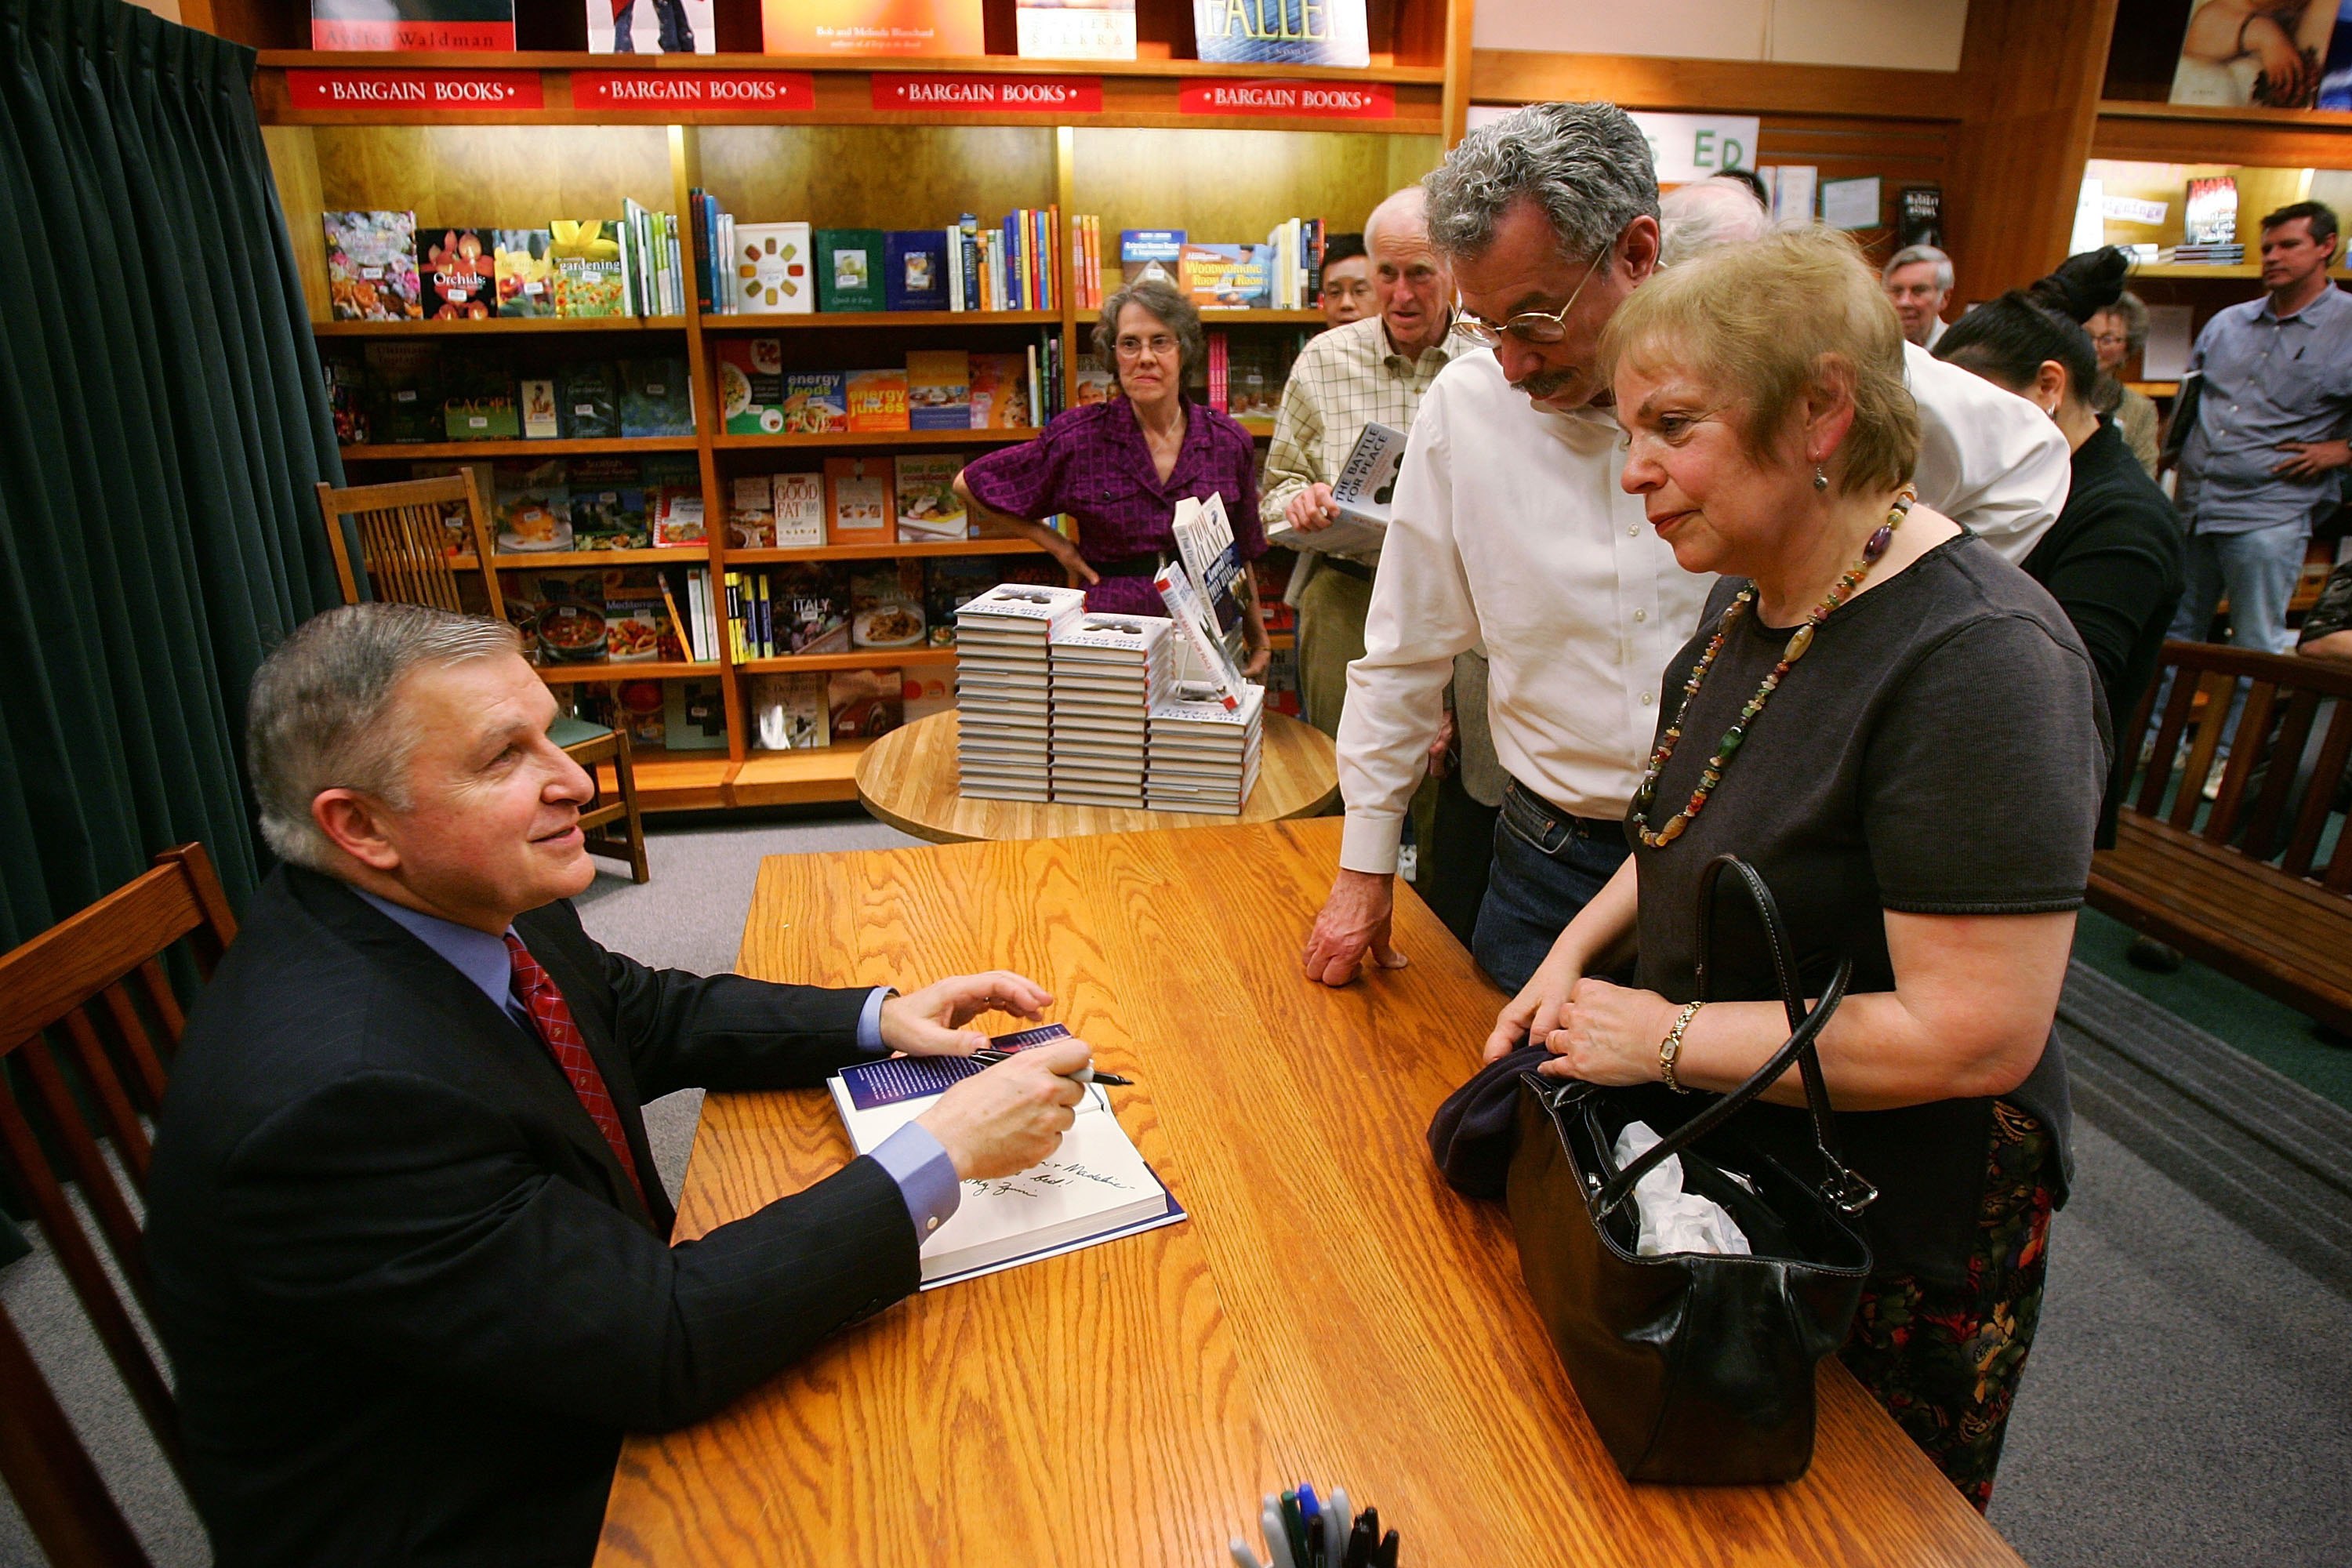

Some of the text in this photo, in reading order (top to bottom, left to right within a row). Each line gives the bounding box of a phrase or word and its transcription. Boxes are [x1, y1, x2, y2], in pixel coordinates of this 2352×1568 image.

[1204, 0, 1335, 39] FALLE
[397, 31, 494, 47] Waldman
[815, 26, 834, 37] Bob
[332, 82, 504, 101] BARGAIN BOOKS
[611, 80, 776, 100] BARGAIN BOOKS
[909, 82, 1066, 103] BARGAIN BOOKS
[1215, 88, 1362, 110] BARGAIN BOOKS
[559, 257, 620, 274] gardening
[434, 271, 486, 285] Orchids:
[788, 375, 840, 387] energy
[849, 390, 906, 403] energy
[1336, 478, 1351, 502] THE
[1348, 429, 1379, 474] BATTLE
[776, 483, 818, 501] GOOD
[1347, 478, 1363, 503] FOR
[793, 597, 829, 613] ITALY
